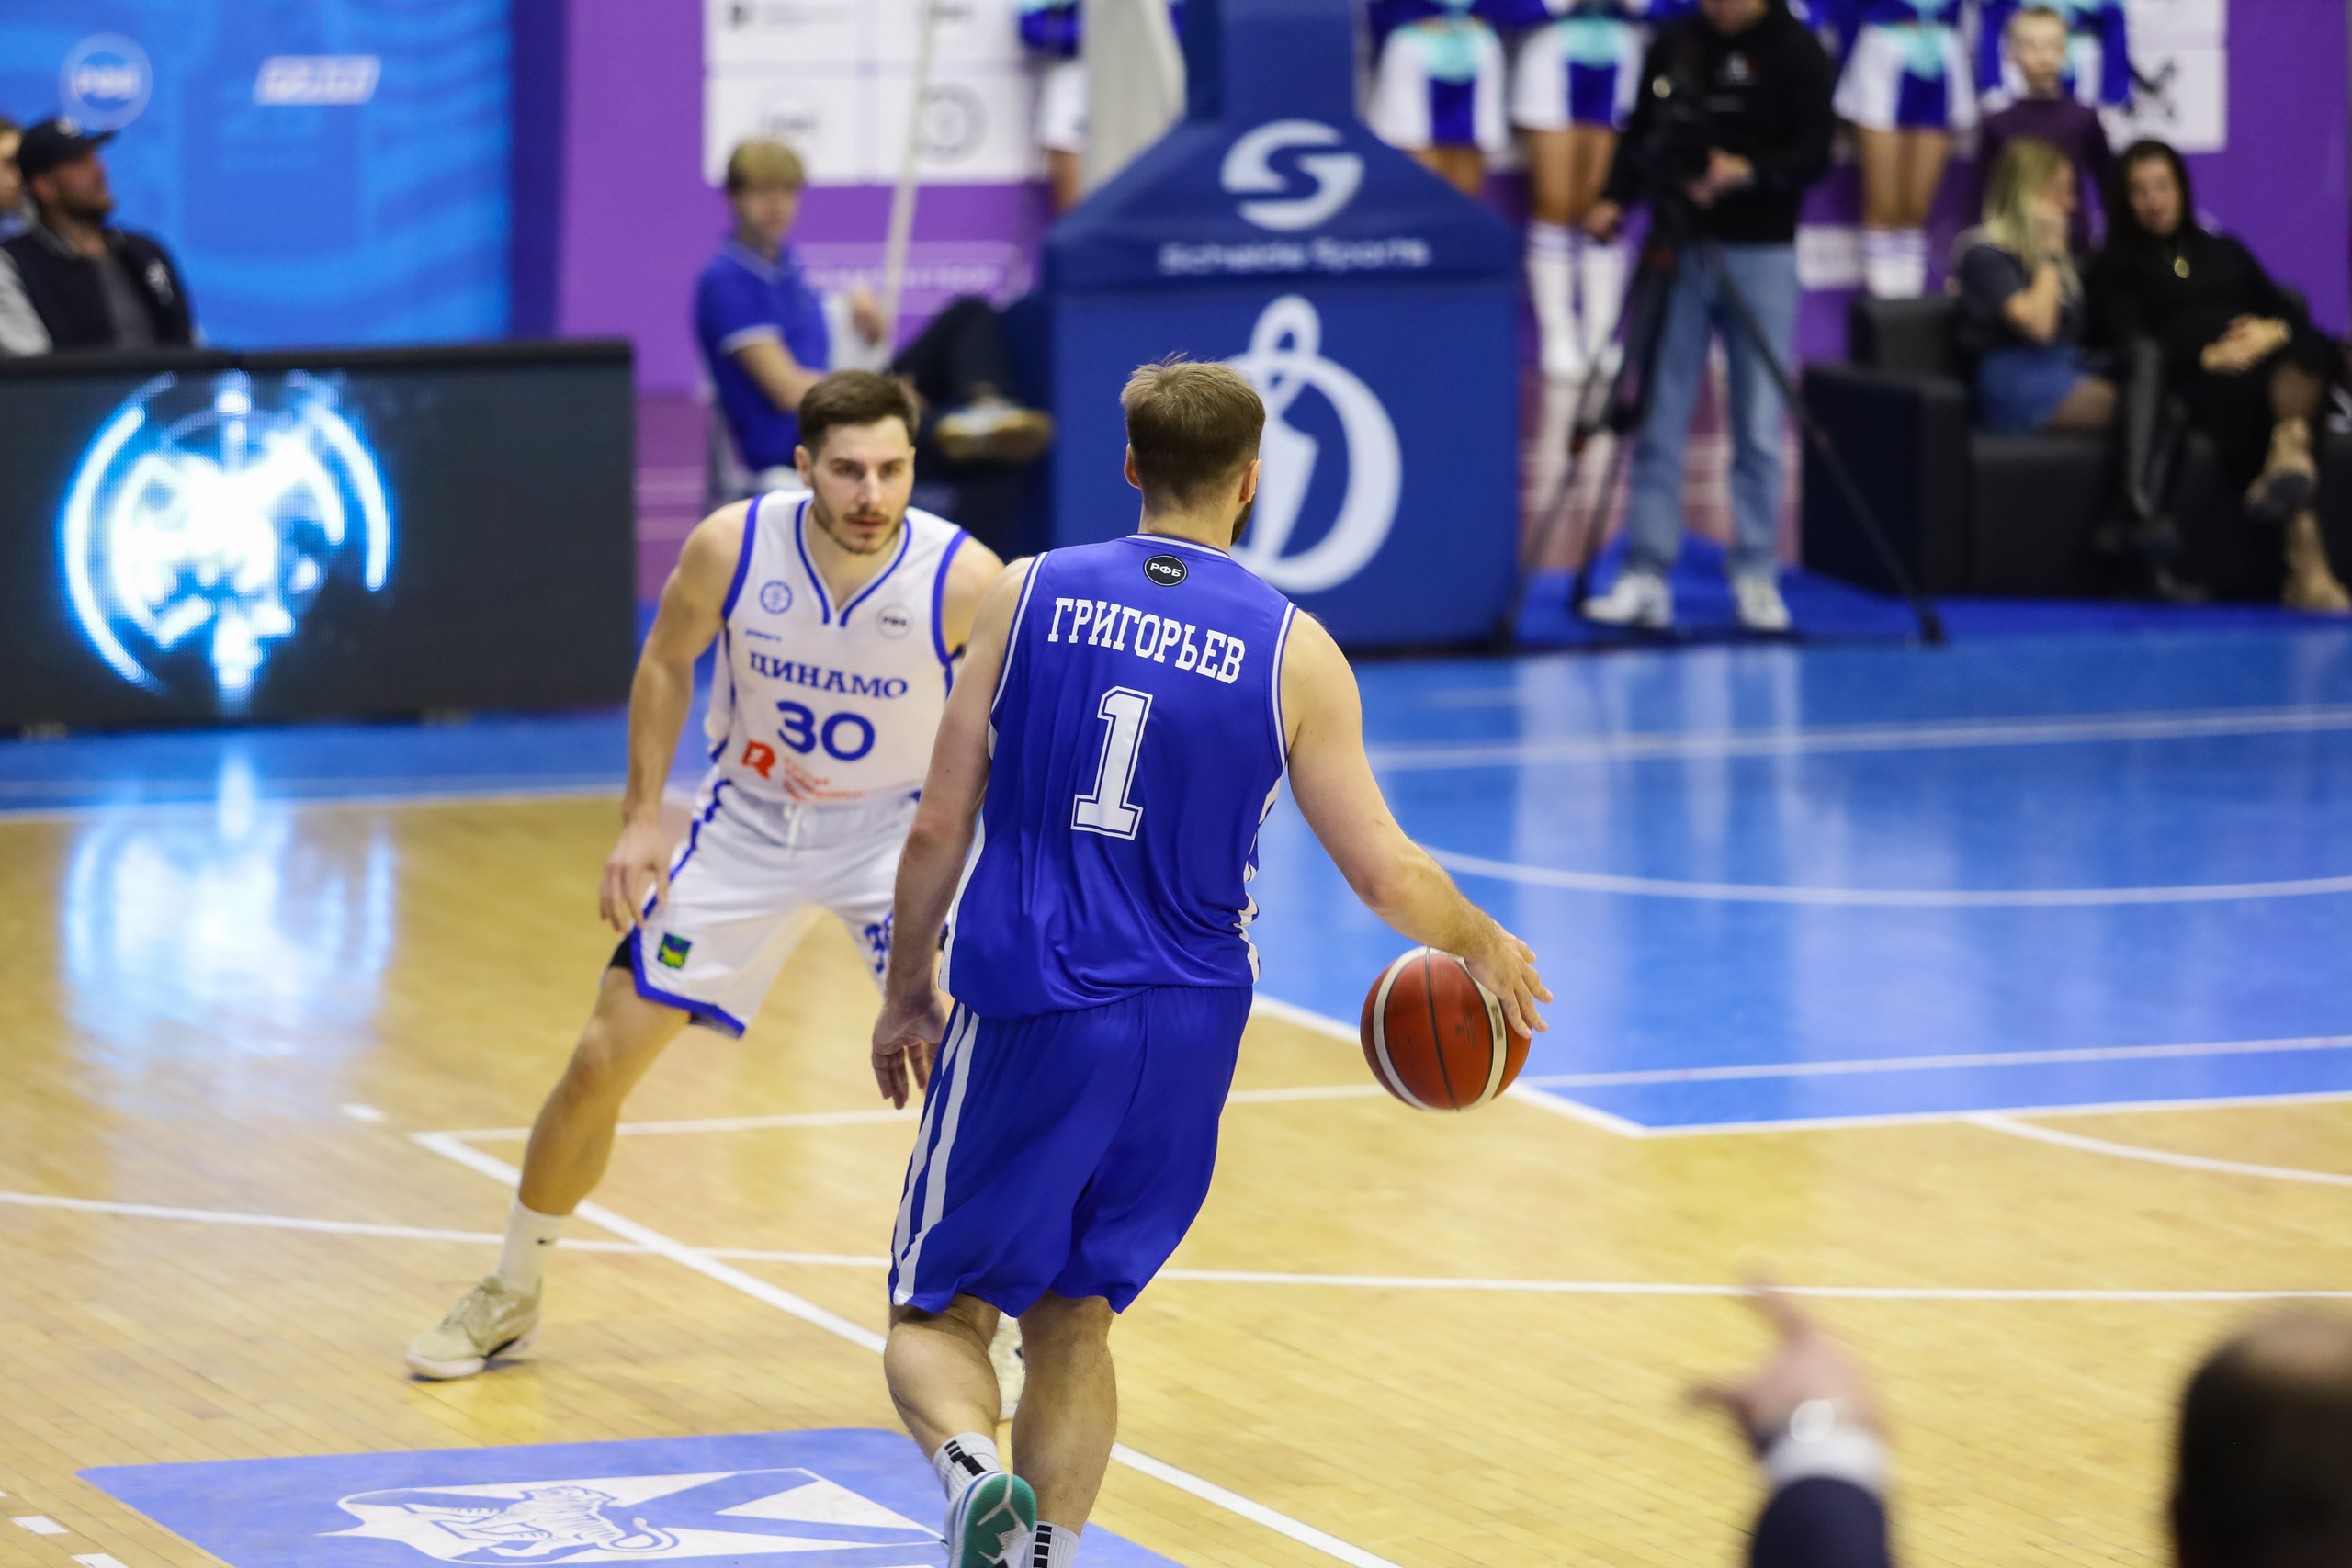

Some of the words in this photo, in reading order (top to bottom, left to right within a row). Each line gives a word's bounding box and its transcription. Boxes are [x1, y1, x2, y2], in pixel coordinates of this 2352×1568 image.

[1149, 562, 1182, 578] РФБ
[1047, 597, 1246, 684] ГРИГОРЬЕВ
[775, 699, 876, 762] 30
[1070, 685, 1153, 840] 1
